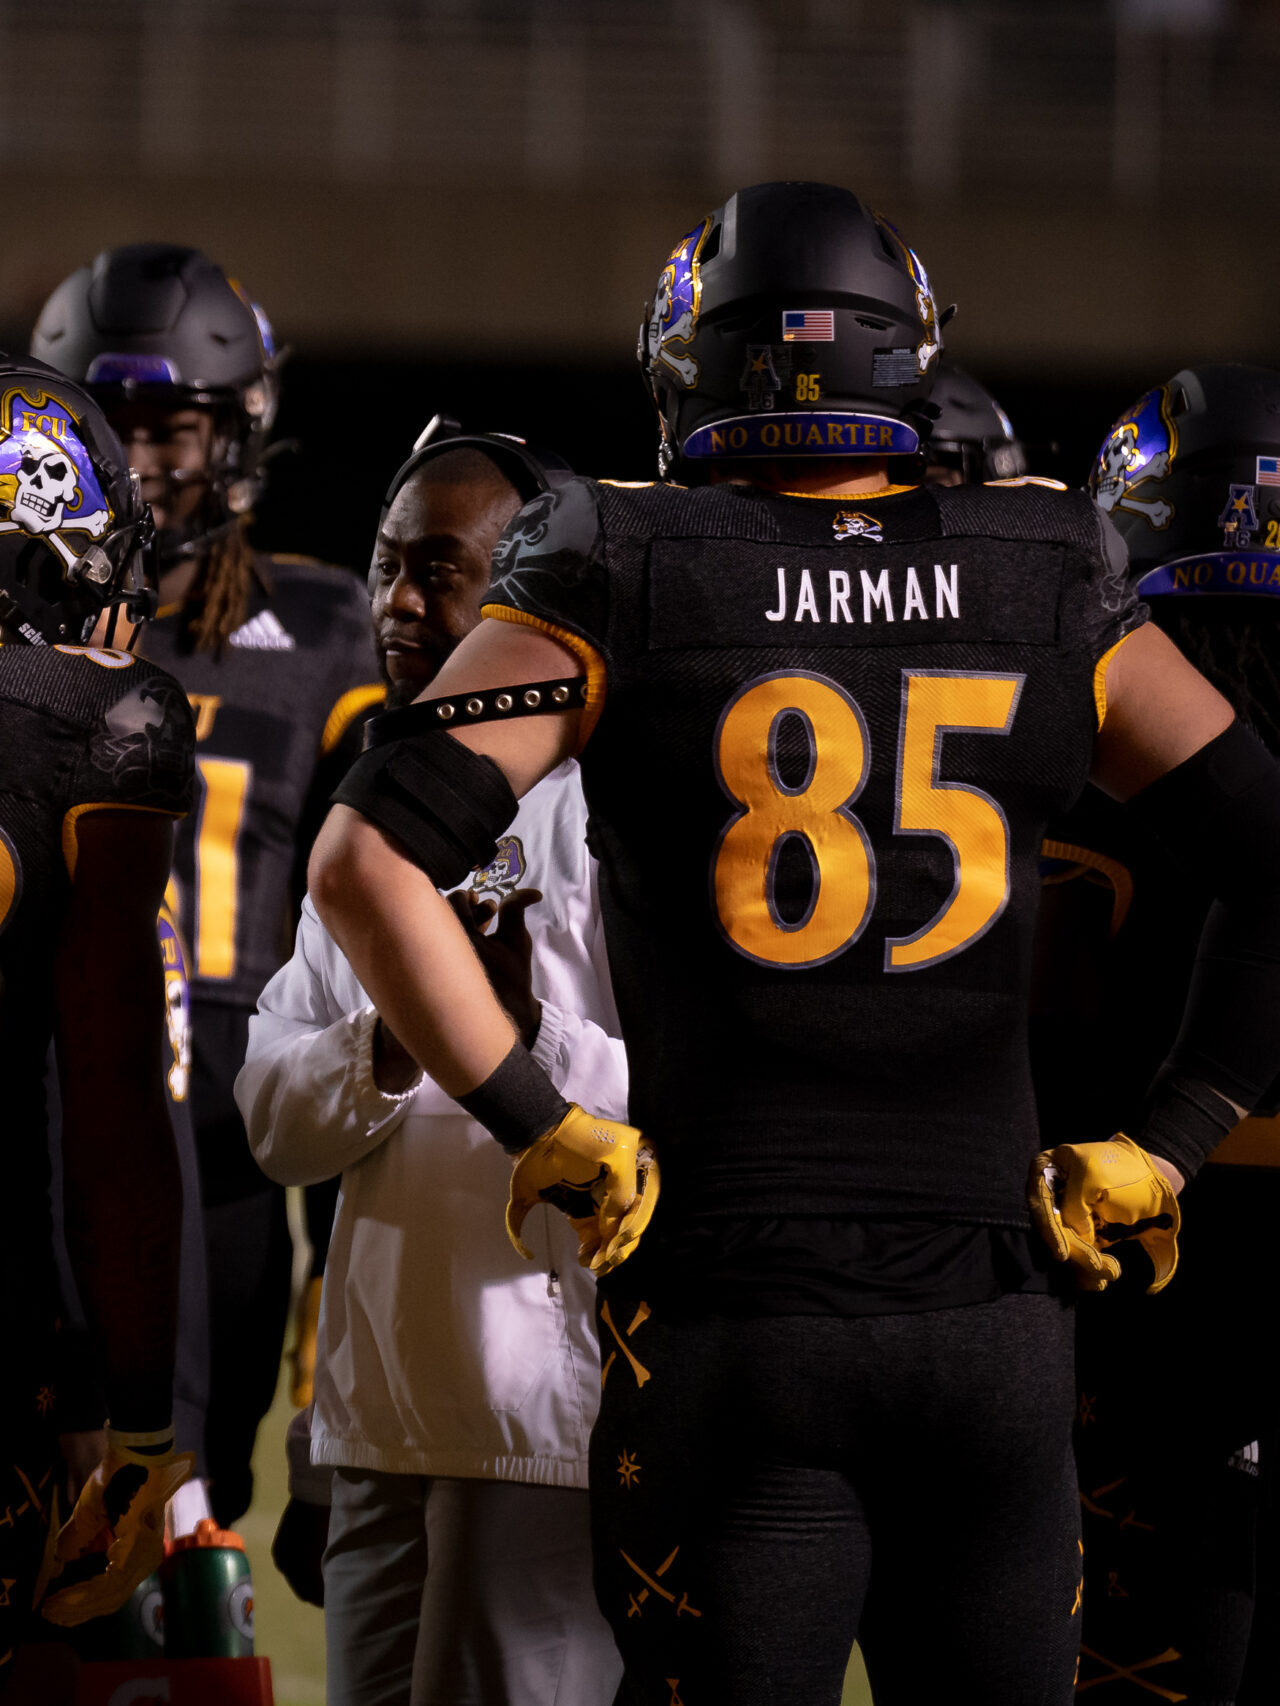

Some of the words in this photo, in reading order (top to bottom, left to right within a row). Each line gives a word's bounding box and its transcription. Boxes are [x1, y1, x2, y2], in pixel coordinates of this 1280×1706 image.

[796, 373, 821, 402] 85
[21, 411, 66, 440] ECU
[710, 426, 749, 452] NO
[760, 422, 894, 447] QUARTER
[1172, 562, 1214, 589] NO
[764, 565, 961, 624] JARMAN
[708, 668, 1027, 973] 85
